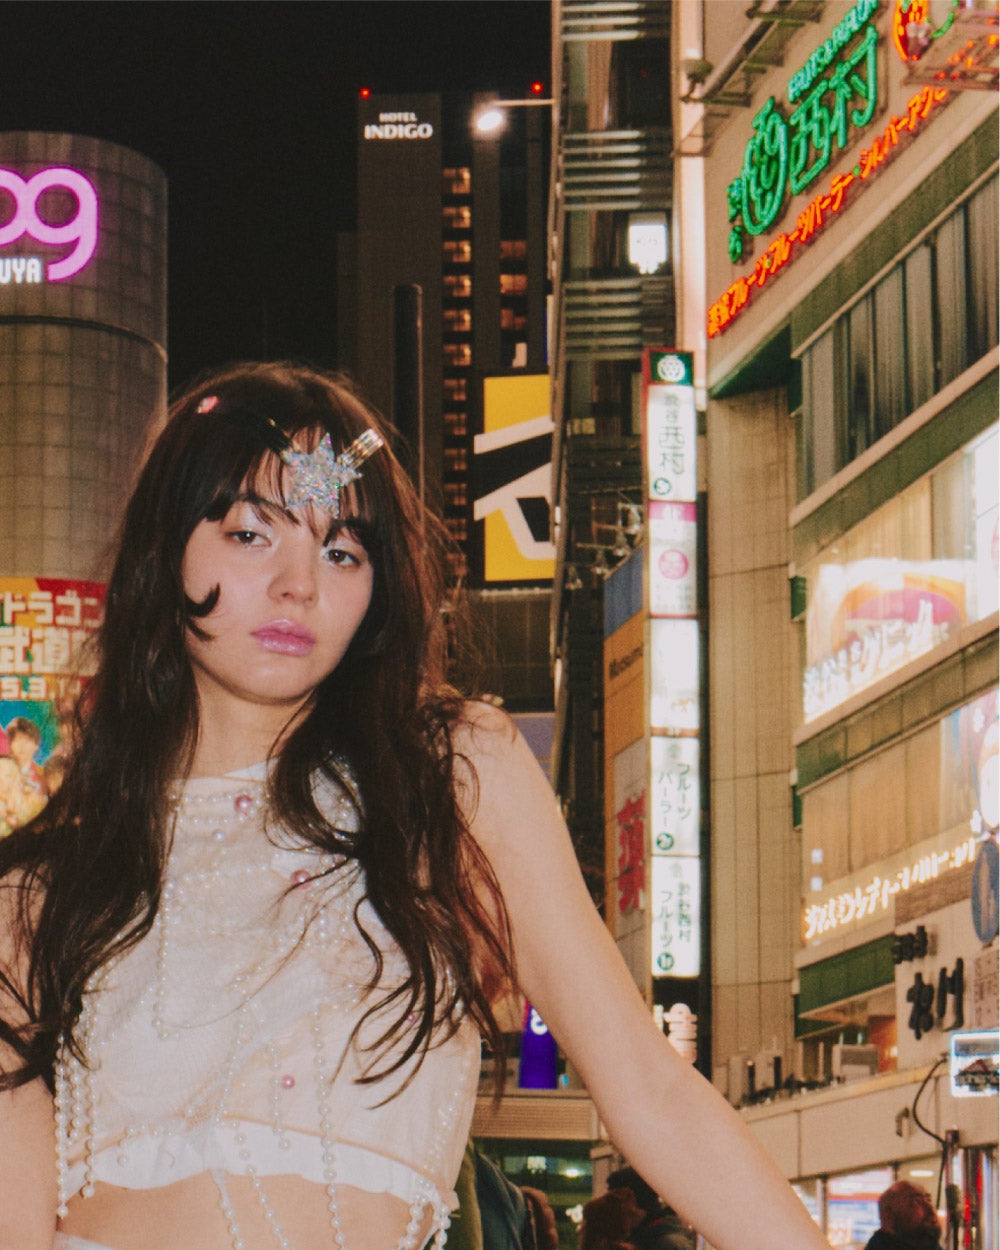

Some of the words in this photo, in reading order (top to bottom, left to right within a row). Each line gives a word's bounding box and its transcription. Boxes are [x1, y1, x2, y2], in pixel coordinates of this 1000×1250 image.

[364, 123, 434, 140] INDIGO
[379, 111, 417, 123] HOTEL
[658, 771, 673, 828] パーラー
[677, 763, 691, 821] フルーツ
[658, 890, 673, 948] フルーツ
